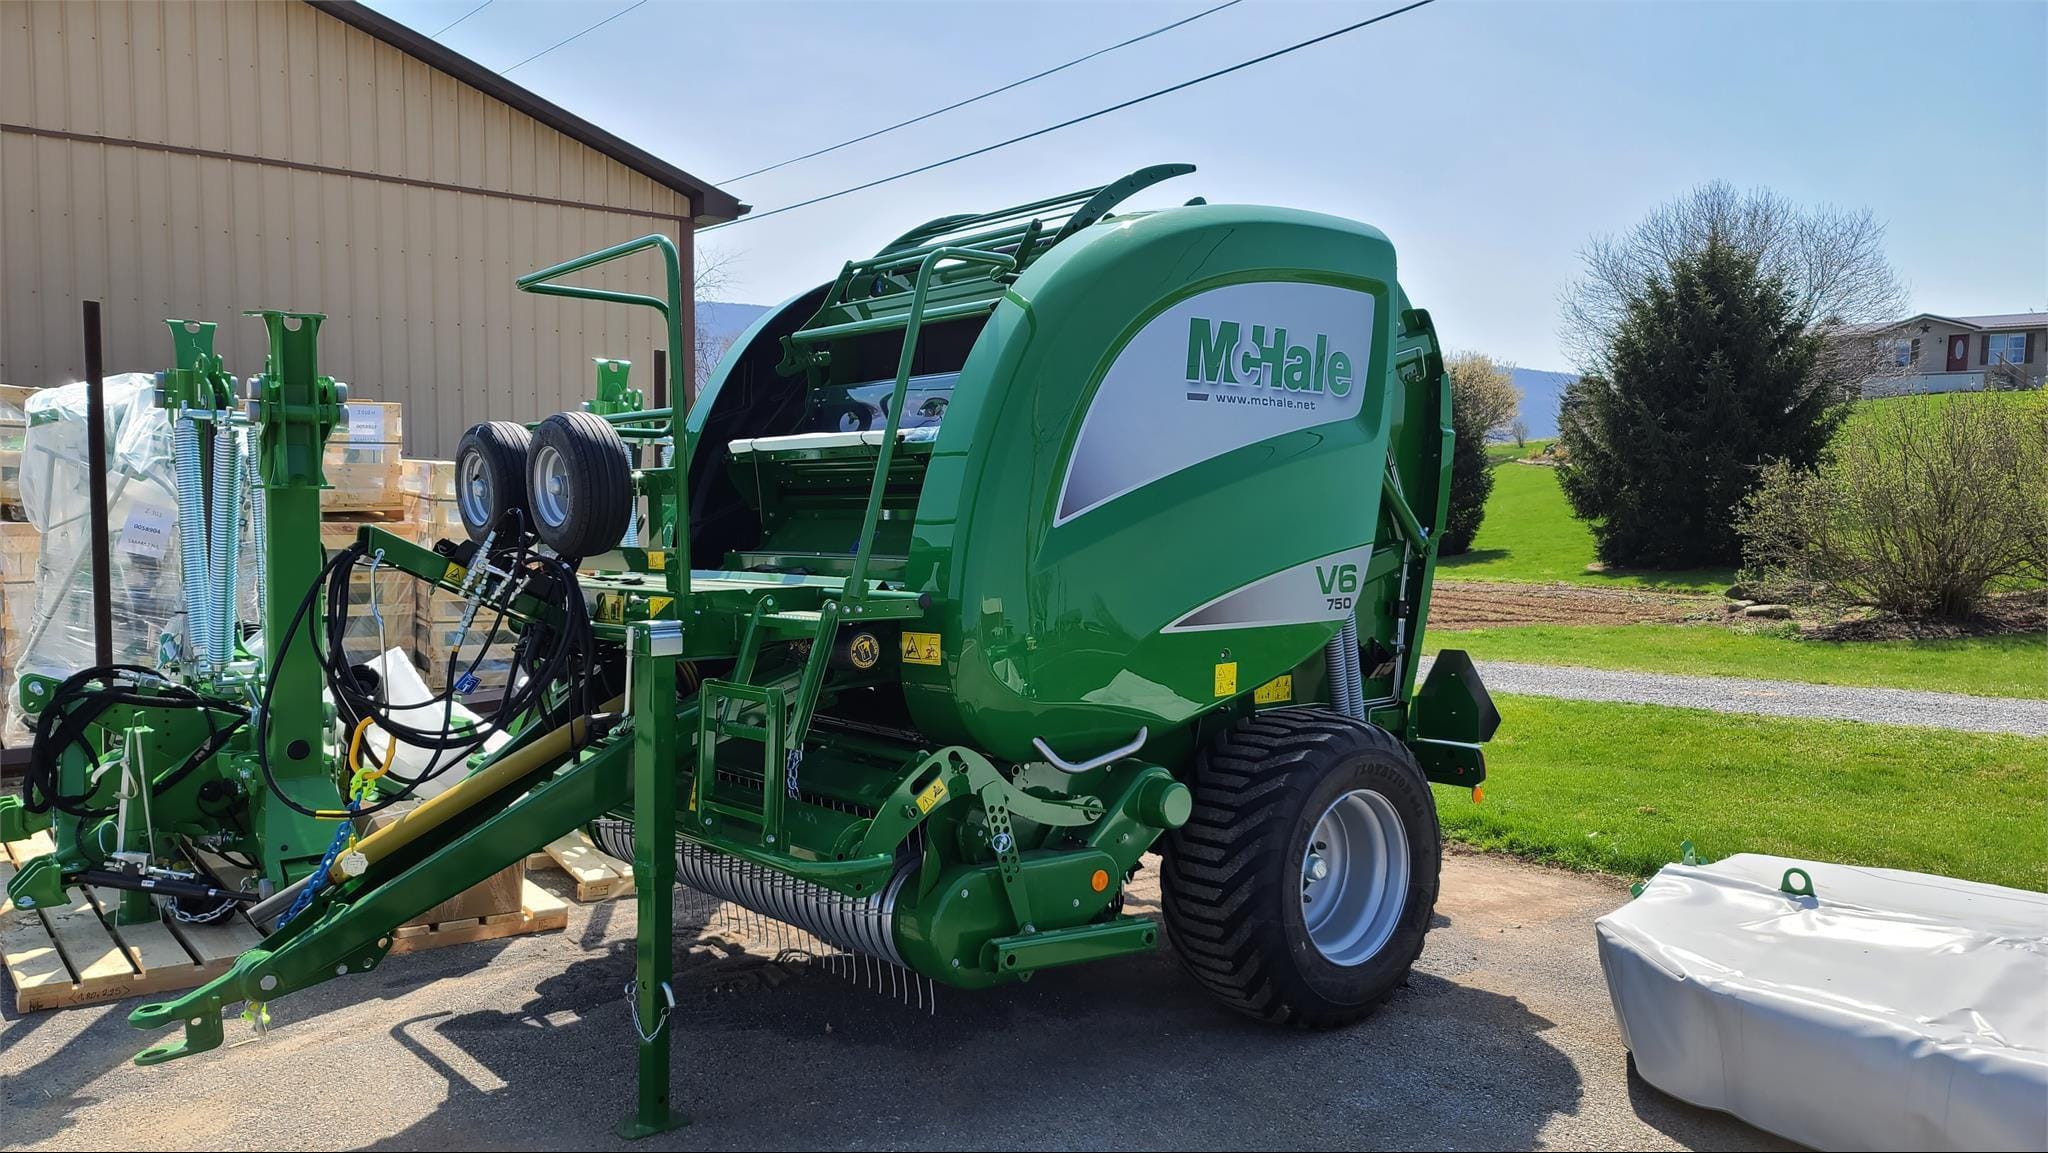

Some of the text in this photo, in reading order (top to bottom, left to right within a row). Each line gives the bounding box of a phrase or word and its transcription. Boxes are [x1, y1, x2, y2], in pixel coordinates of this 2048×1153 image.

[1185, 316, 1353, 398] McHale
[1215, 393, 1316, 411] www.mchale.net
[1315, 563, 1358, 595] V6
[1326, 597, 1352, 611] 750
